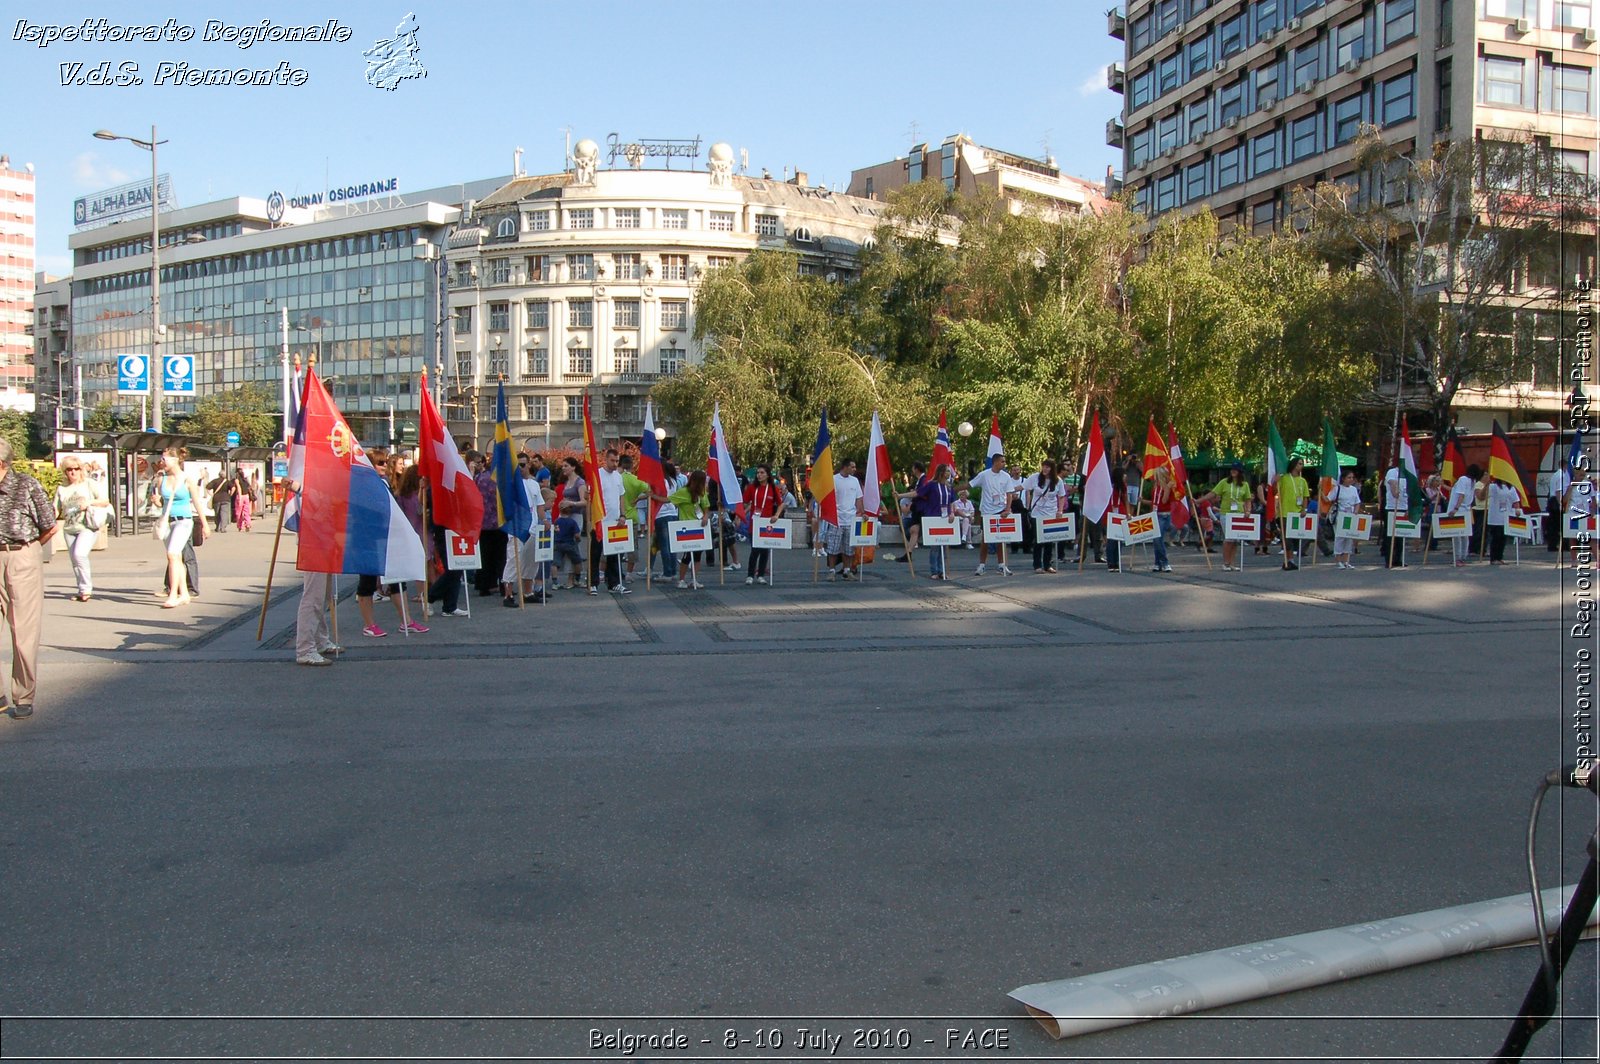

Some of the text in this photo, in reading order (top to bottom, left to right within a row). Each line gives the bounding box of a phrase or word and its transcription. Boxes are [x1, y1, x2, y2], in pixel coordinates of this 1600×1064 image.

[91, 191, 126, 217] ALPHA
[290, 177, 398, 209] DUNAV OSIGURANJE
